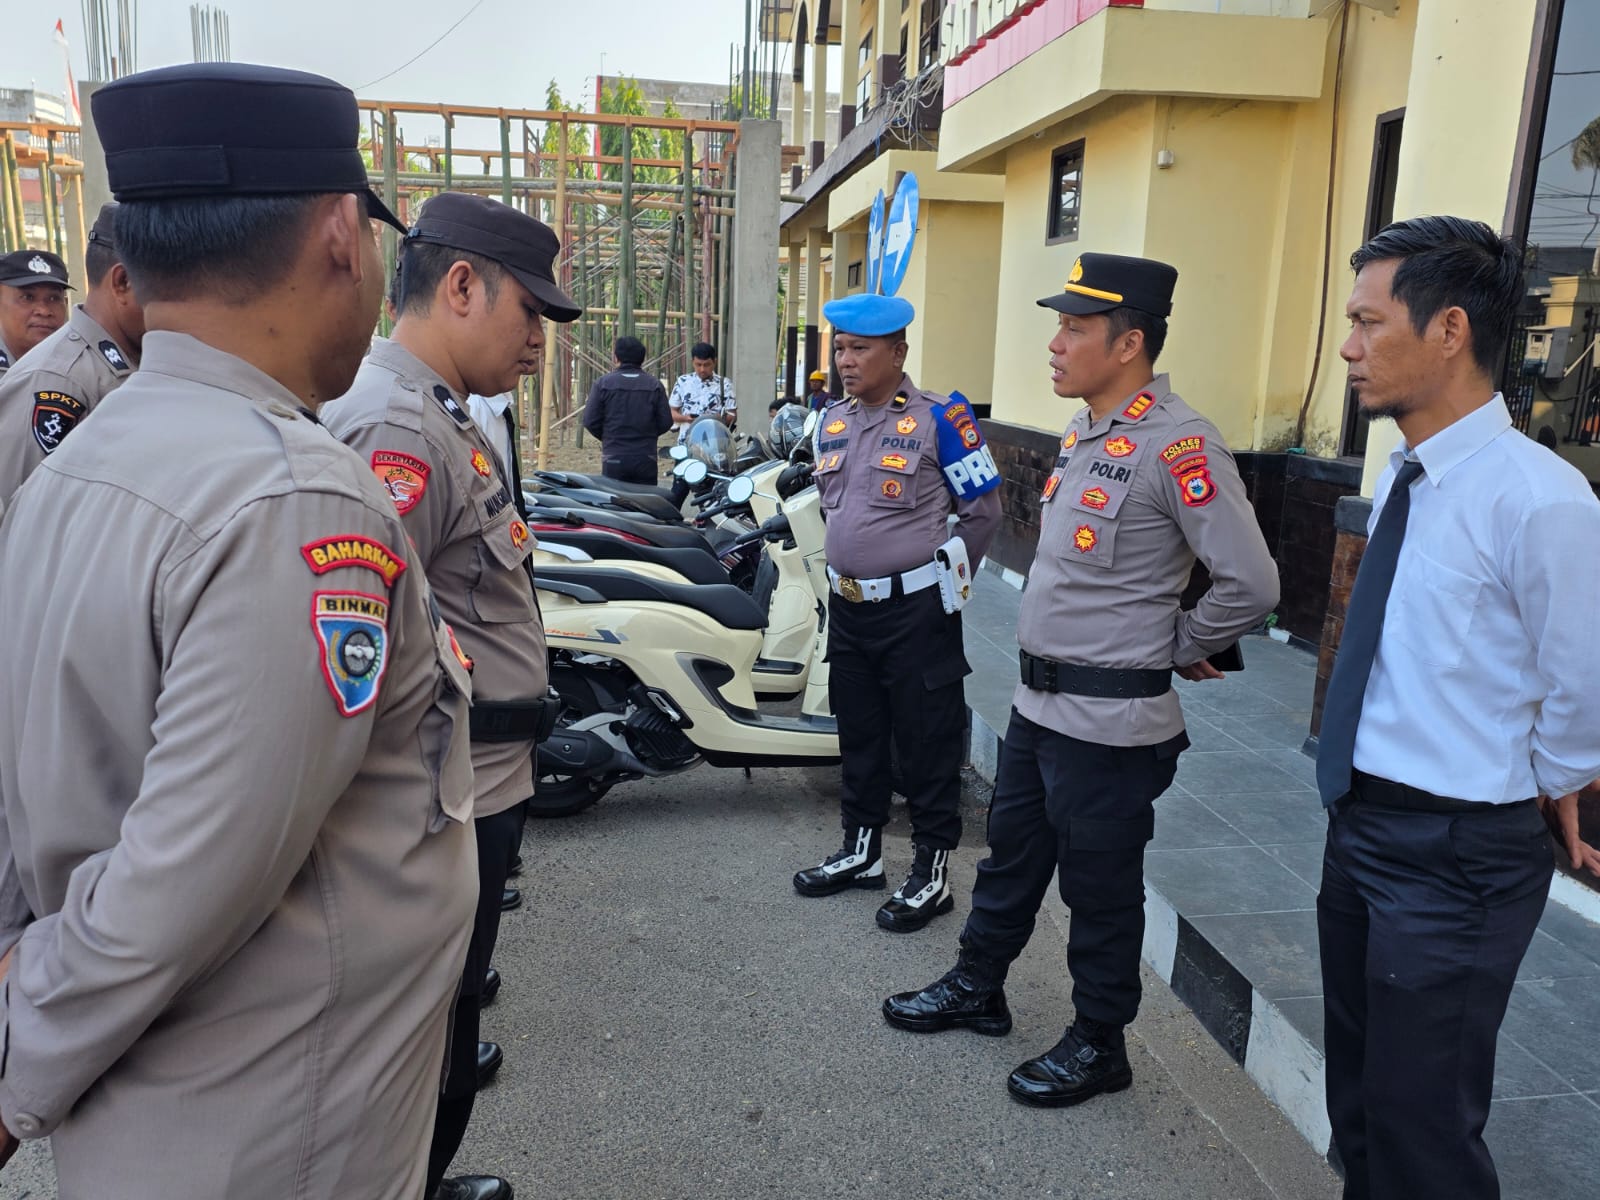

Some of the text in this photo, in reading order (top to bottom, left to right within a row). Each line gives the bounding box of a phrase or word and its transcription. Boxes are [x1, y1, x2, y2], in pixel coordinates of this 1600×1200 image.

[39, 392, 80, 408] SPKT
[881, 436, 922, 450] POLRI
[1163, 438, 1200, 459] POLRES
[1089, 461, 1131, 483] POLRI
